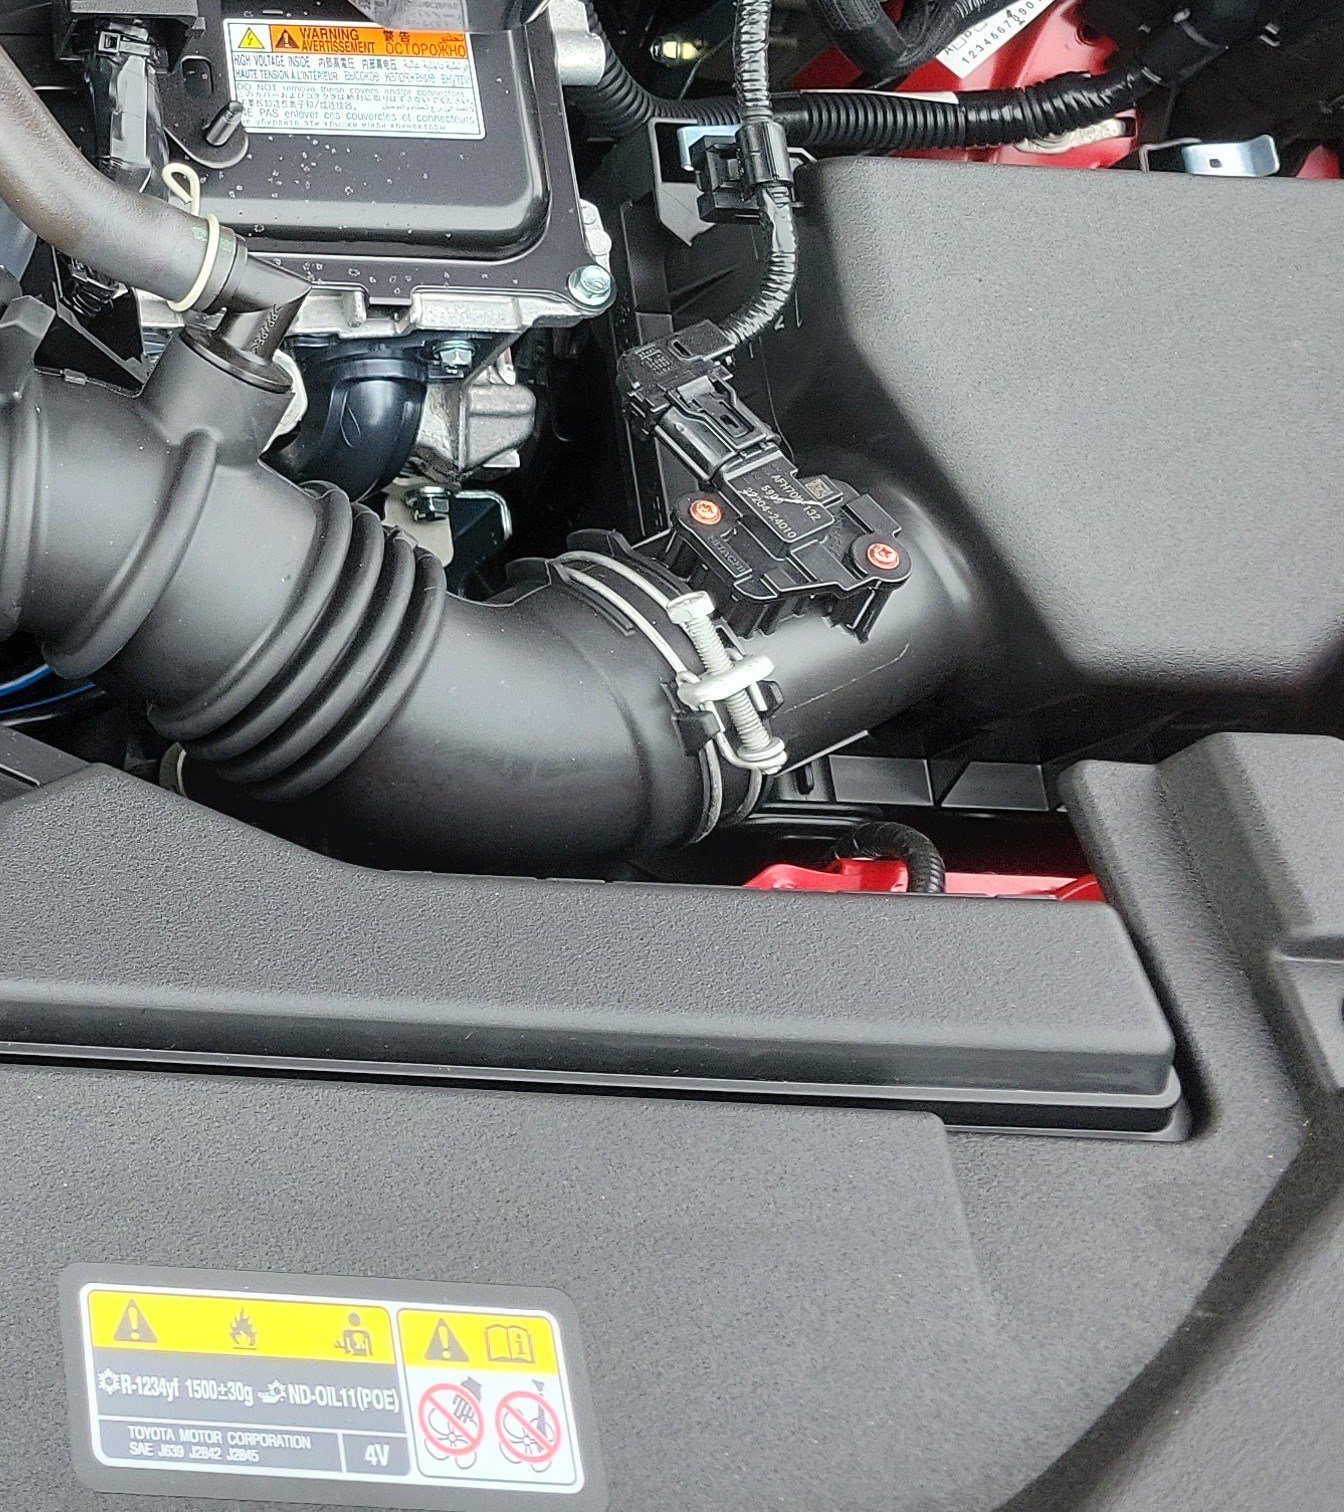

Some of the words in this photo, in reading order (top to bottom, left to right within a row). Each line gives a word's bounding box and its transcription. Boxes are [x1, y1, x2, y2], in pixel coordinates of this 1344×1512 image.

[299, 26, 360, 40] WARNING
[383, 29, 411, 43] 警告
[301, 40, 376, 54] AVERTISSEMENT
[385, 42, 467, 58] ОСТОРОЖНО
[234, 54, 252, 67] HIGH
[254, 55, 286, 68] VOLTAGE
[288, 55, 311, 68] INSIDE
[235, 69, 258, 79] HAUTE
[260, 69, 289, 80] TENSION
[236, 82, 252, 92] DO
[257, 83, 277, 93] NOT
[259, 107, 279, 118] PAS
[120, 1374, 179, 1402] R-1234yf
[127, 1425, 176, 1441] TOYOTA
[179, 1427, 224, 1444] MOTOR
[226, 1431, 312, 1450] CORPORATION
[129, 1441, 154, 1457] SAE
[364, 1443, 391, 1467] 4V
